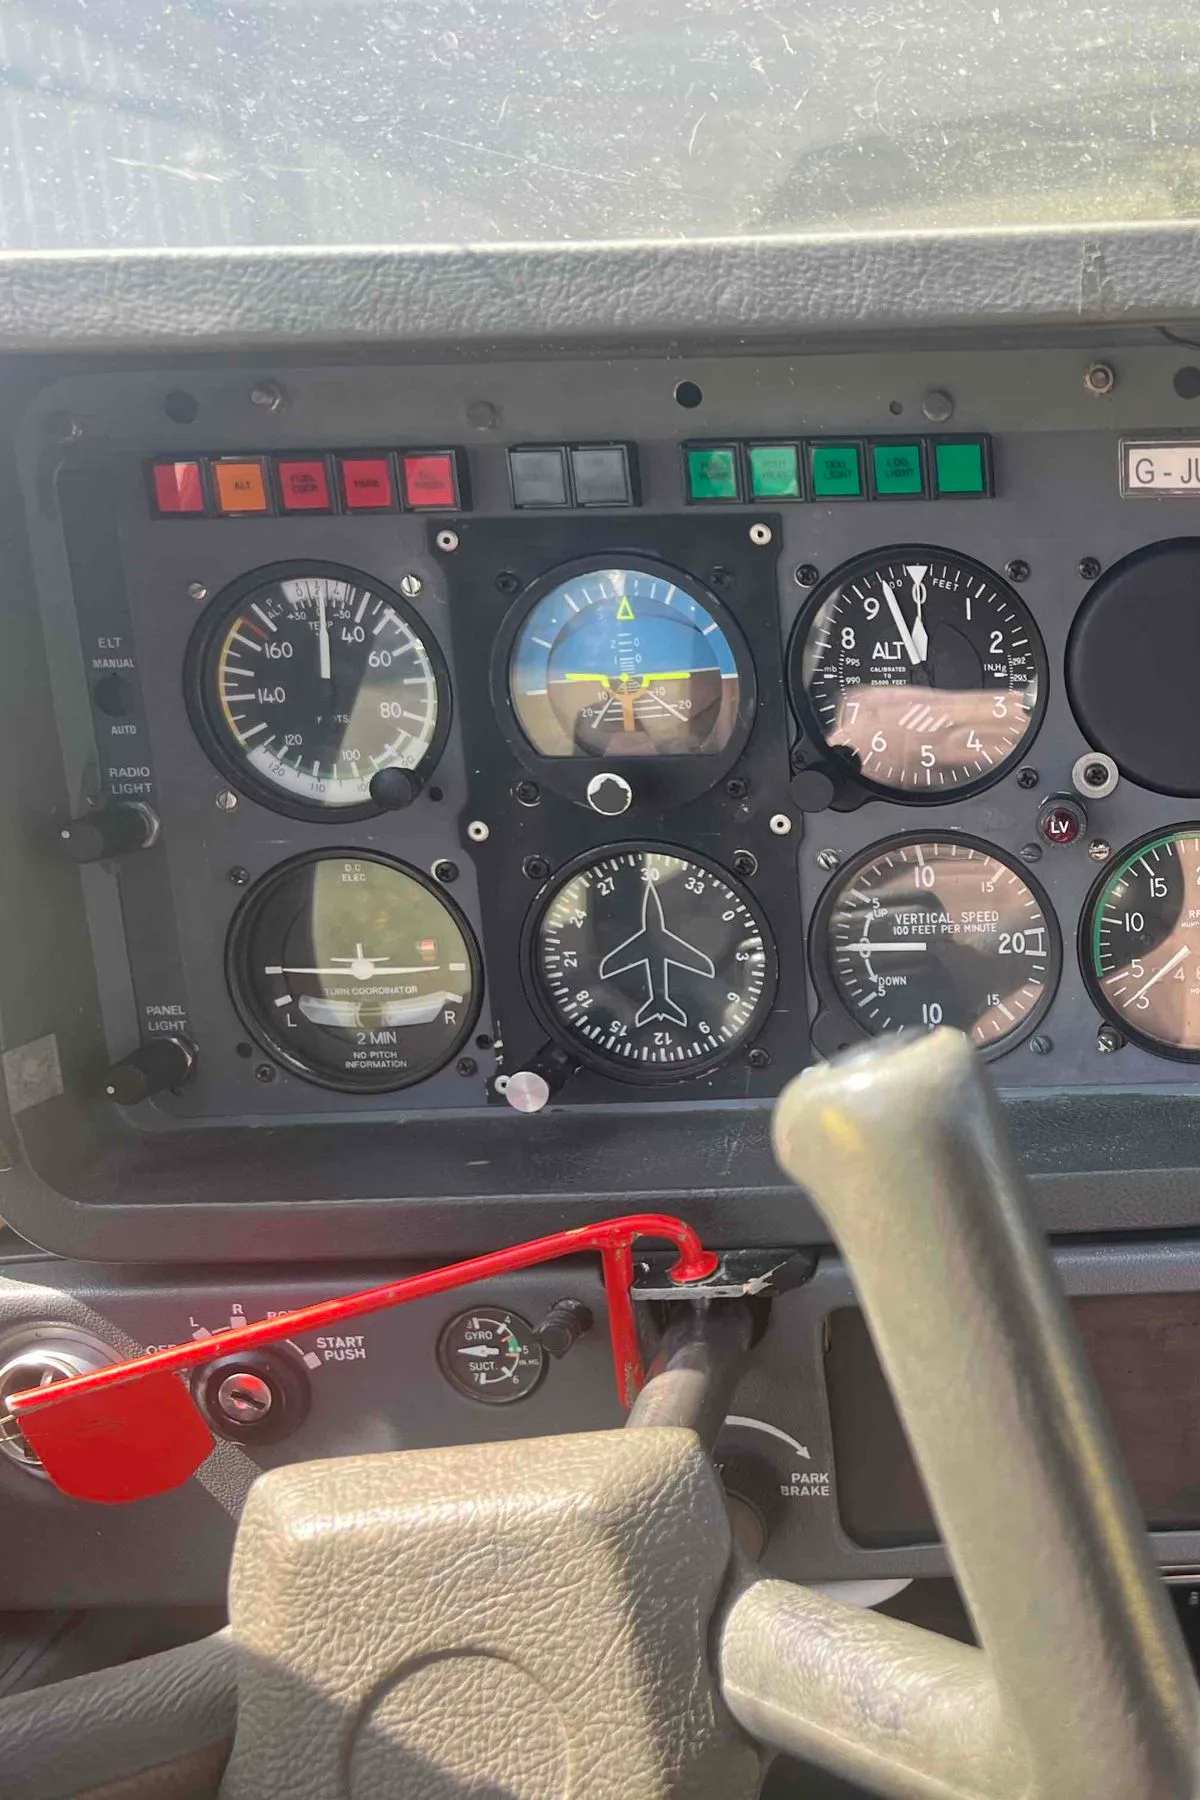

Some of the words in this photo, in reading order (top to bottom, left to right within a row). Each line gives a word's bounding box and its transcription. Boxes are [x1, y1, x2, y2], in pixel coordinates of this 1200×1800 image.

[932, 577, 959, 592] FEET
[863, 597, 880, 620] 9
[965, 597, 972, 620] 1
[341, 624, 366, 643] 40
[841, 627, 856, 650] 8
[98, 637, 122, 648] ELT
[989, 631, 1004, 654] 2
[264, 641, 293, 659] 160
[872, 641, 905, 660] ALT
[92, 658, 136, 669] MANUAL
[368, 651, 391, 668] 60
[845, 657, 861, 668] 995
[823, 665, 838, 673] mb
[845, 676, 861, 686] 990
[258, 686, 286, 703] 140
[598, 691, 609, 701] 10
[380, 701, 402, 719] 80
[678, 700, 692, 710] 20
[991, 695, 1008, 718] 3
[582, 707, 594, 718] 20
[846, 702, 860, 724] 7
[111, 725, 137, 736] AUTO
[285, 733, 302, 746] 120
[871, 730, 888, 751] 6
[966, 730, 984, 752] 4
[342, 749, 361, 761] 100
[920, 744, 936, 768] 5
[109, 766, 151, 778] RADIO
[267, 761, 286, 777] 120
[112, 782, 153, 794] LIGHT
[310, 782, 326, 793] 110
[1051, 820, 1069, 834] LV
[342, 873, 367, 882] ELEC
[640, 867, 660, 881] 30
[914, 866, 935, 888] 10
[596, 877, 616, 897] 27
[684, 877, 706, 896] 33
[981, 882, 995, 893] 15
[1149, 877, 1168, 898] 15
[871, 897, 880, 909] 5
[569, 907, 588, 929] 24
[721, 909, 736, 923] 0
[873, 908, 888, 919] UP
[895, 911, 953, 925] VERTICAL
[961, 910, 999, 923] SPEED
[1125, 912, 1145, 932] 10
[893, 925, 910, 936] 100
[911, 925, 938, 936] FEET
[940, 925, 961, 934] PER
[963, 923, 998, 934] MINUTE
[998, 932, 1026, 955] 20
[563, 949, 578, 969] 21
[735, 951, 750, 963] 3
[1131, 959, 1144, 978] 5
[877, 975, 907, 986] DOWN
[324, 987, 350, 997] TURN
[351, 985, 418, 996] COORDINATOR
[877, 986, 886, 997] 5
[576, 988, 595, 1010] 18
[987, 993, 1000, 1005] 15
[146, 1004, 186, 1016] PANEL
[922, 1003, 943, 1025] 10
[287, 1013, 298, 1028] L
[445, 1010, 457, 1025] R
[148, 1020, 187, 1031] LIGHT
[609, 1019, 628, 1038] 15
[356, 1032, 367, 1045] 2
[370, 1031, 398, 1045] MIN
[653, 1031, 673, 1046] 12
[353, 1050, 368, 1060] NO
[370, 1050, 398, 1060] PITCH
[344, 1059, 408, 1069] INFORMATION
[232, 1304, 244, 1316] R
[189, 1316, 199, 1328] L
[316, 1335, 365, 1349] START
[464, 1330, 493, 1341] GYRO
[323, 1348, 366, 1361] PUSH
[522, 1345, 529, 1355] 5
[512, 1374, 520, 1385] 6
[791, 1472, 830, 1484] PARK
[779, 1484, 831, 1497] BRAKE
